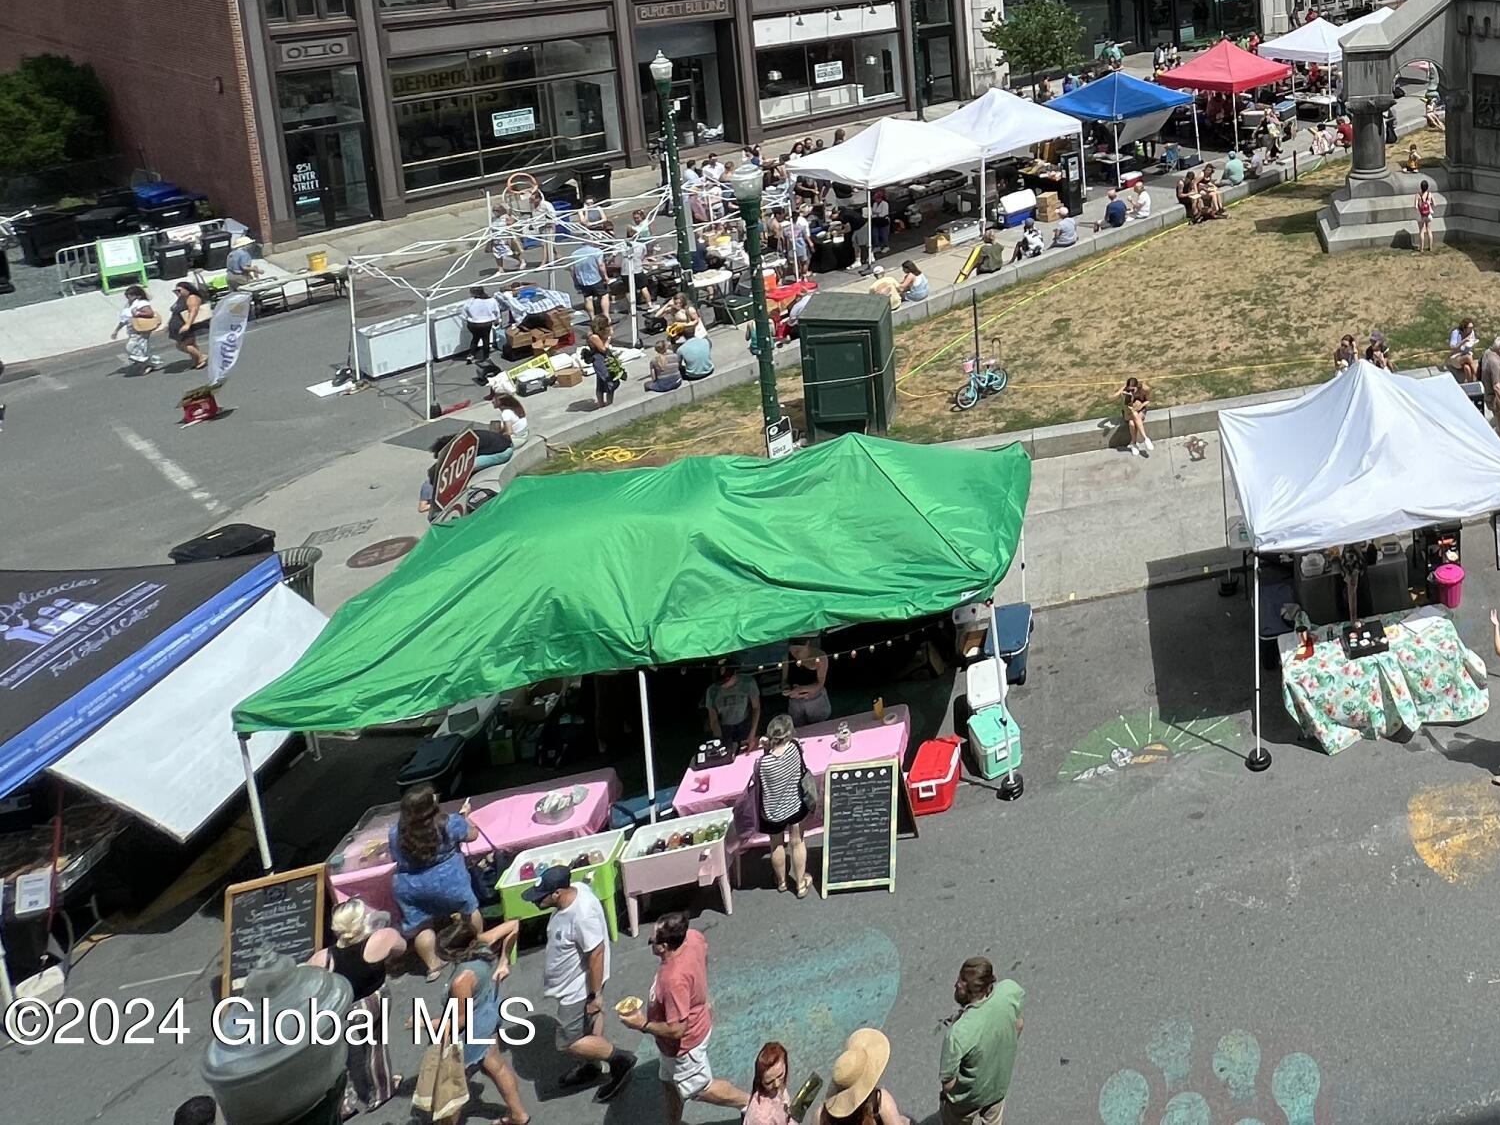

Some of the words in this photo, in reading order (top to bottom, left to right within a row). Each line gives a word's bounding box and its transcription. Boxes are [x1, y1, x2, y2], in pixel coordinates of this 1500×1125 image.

[640, 4, 684, 19] BURDETT
[685, 0, 726, 14] BUILDING
[292, 179, 319, 193] STREET
[293, 171, 316, 183] RIVER
[220, 324, 243, 371] affles
[439, 445, 476, 494] STOP
